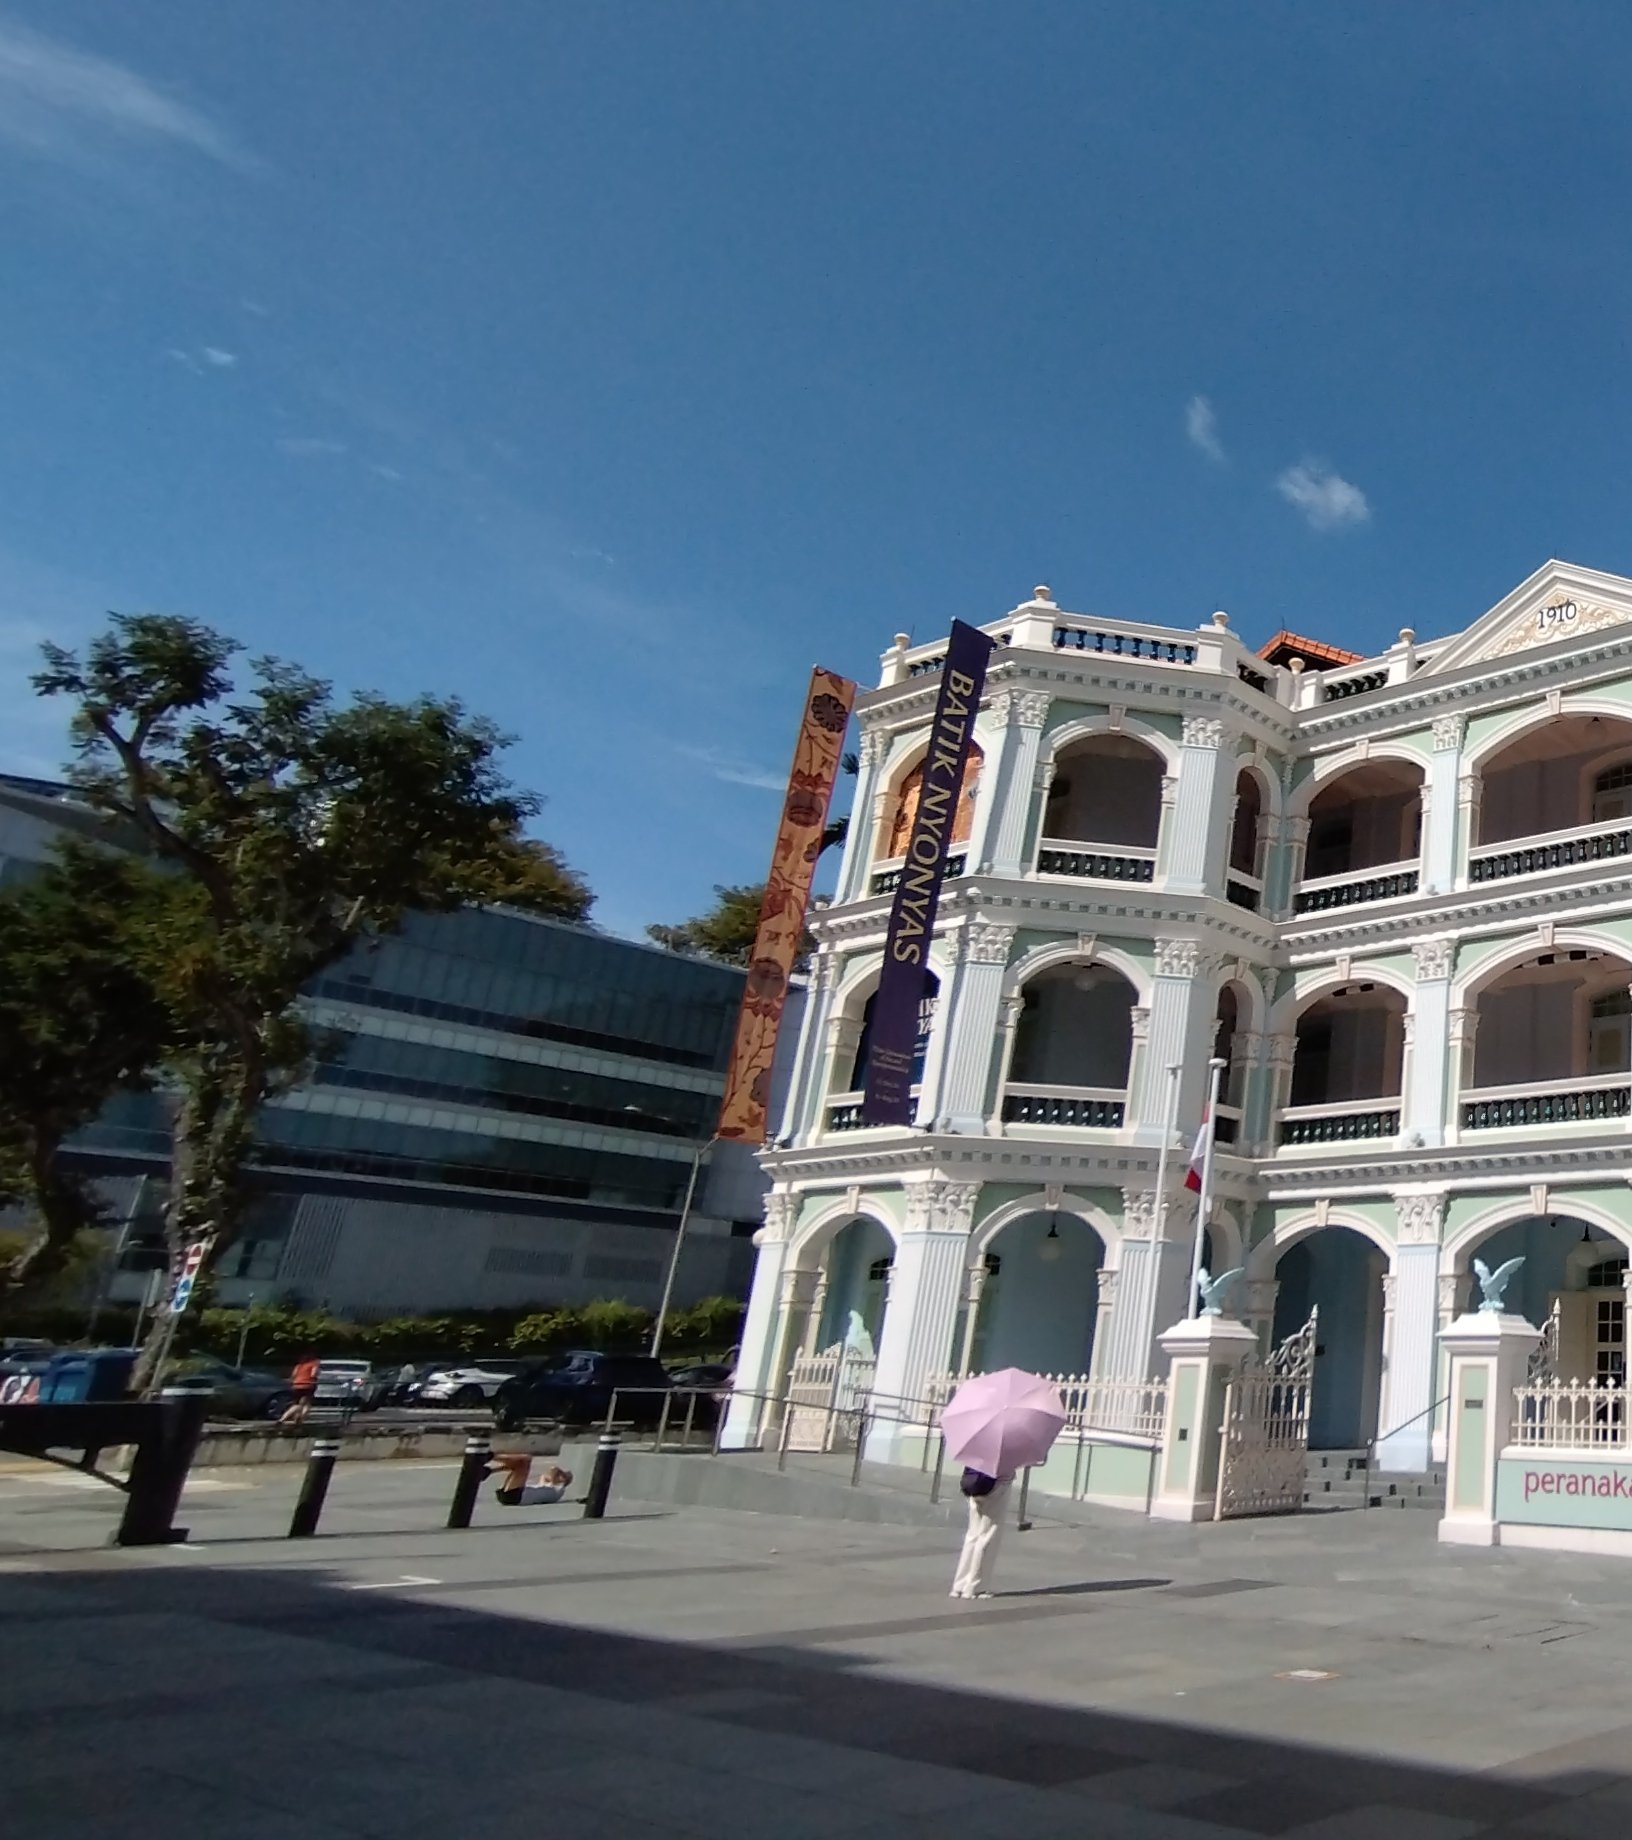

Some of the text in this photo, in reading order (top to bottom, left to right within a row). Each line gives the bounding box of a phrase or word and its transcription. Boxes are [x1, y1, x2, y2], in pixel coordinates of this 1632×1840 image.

[1539, 600, 1577, 629] 1910
[930, 669, 974, 778] BATIK
[893, 782, 952, 966] NYONYAS
